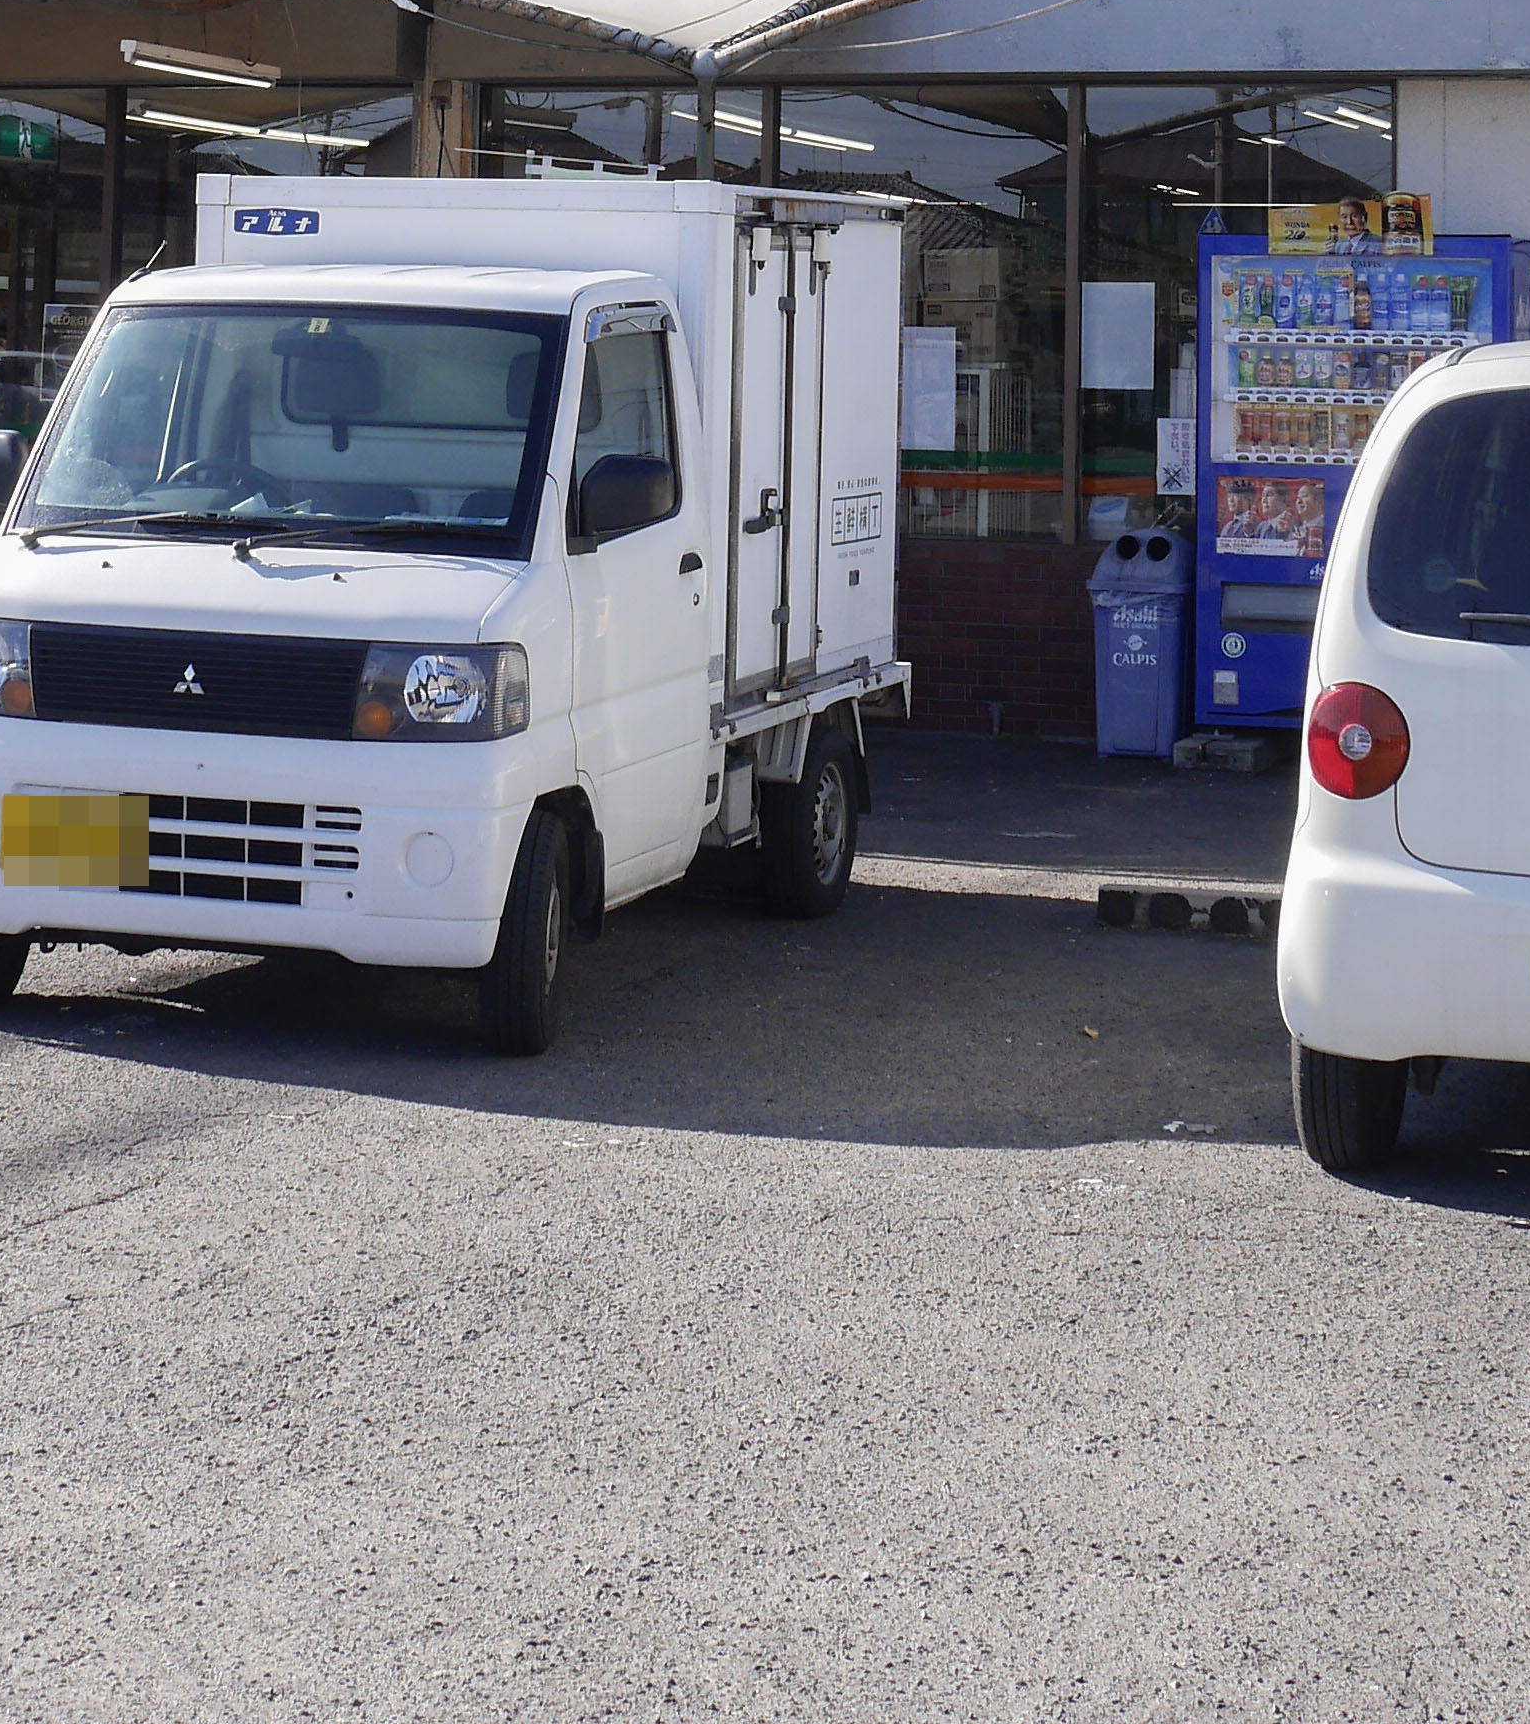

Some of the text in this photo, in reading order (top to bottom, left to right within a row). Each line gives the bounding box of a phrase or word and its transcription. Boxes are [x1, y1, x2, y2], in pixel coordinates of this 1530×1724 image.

[242, 216, 312, 233] アルナ
[1113, 604, 1158, 623] Asahi
[1112, 652, 1158, 667] CALPIS
